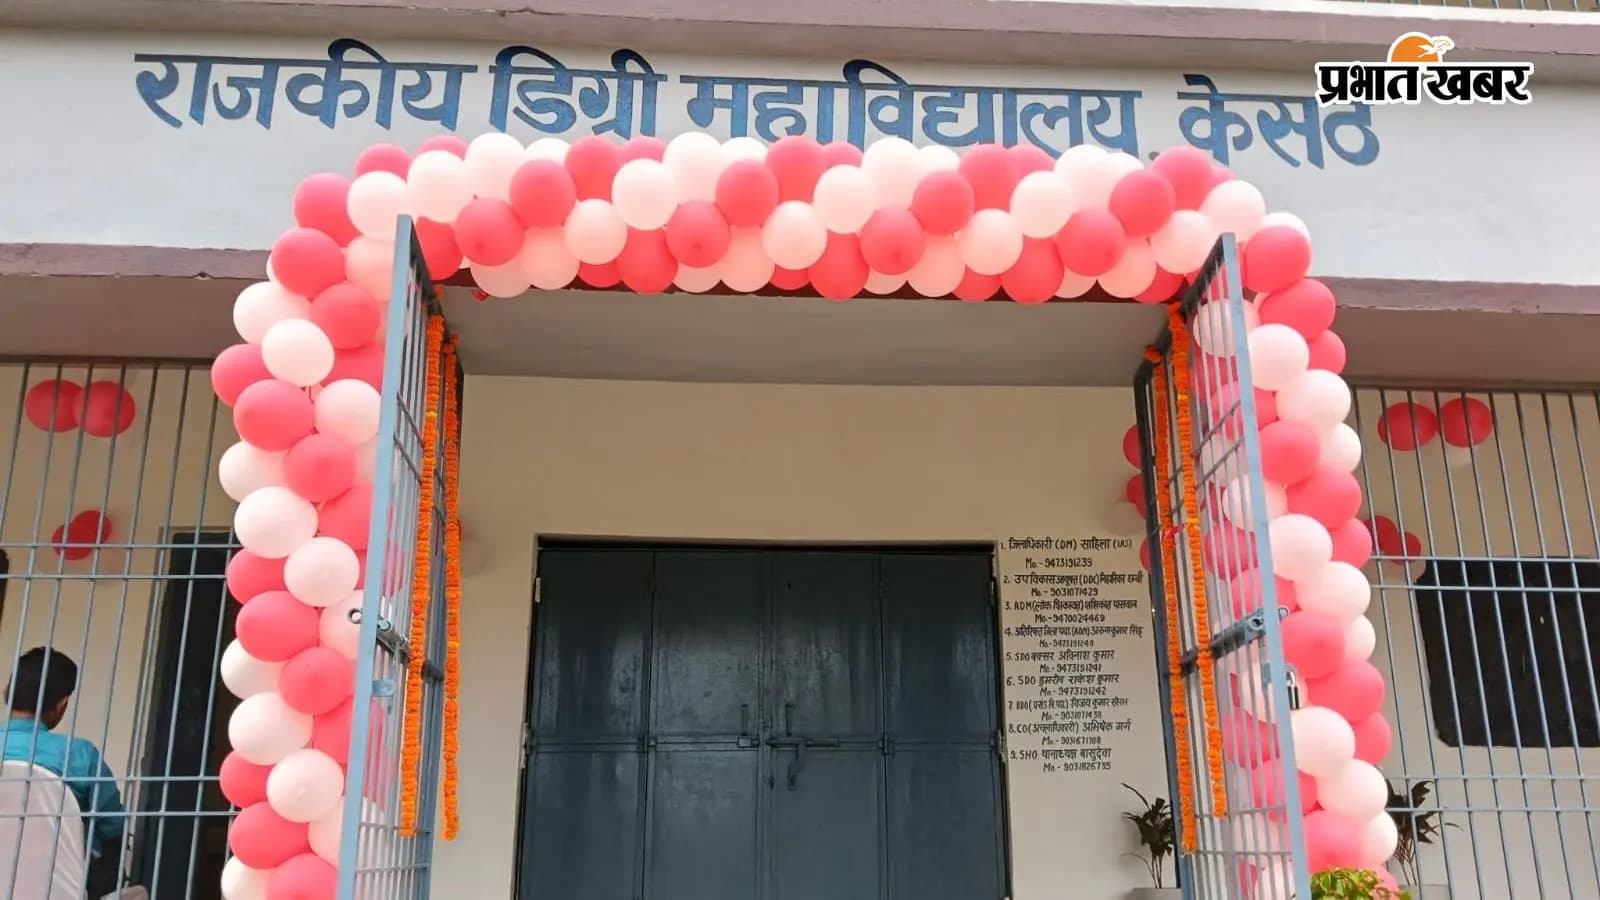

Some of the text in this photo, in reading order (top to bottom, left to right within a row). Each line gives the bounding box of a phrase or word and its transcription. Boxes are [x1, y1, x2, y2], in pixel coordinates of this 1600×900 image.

[135, 38, 1381, 167] राजकीय डिग्री महाविद्यालय केसठ
[1055, 539, 1077, 551] (DM)
[1018, 675, 1036, 685] SDO
[1019, 751, 1038, 760] SHO
